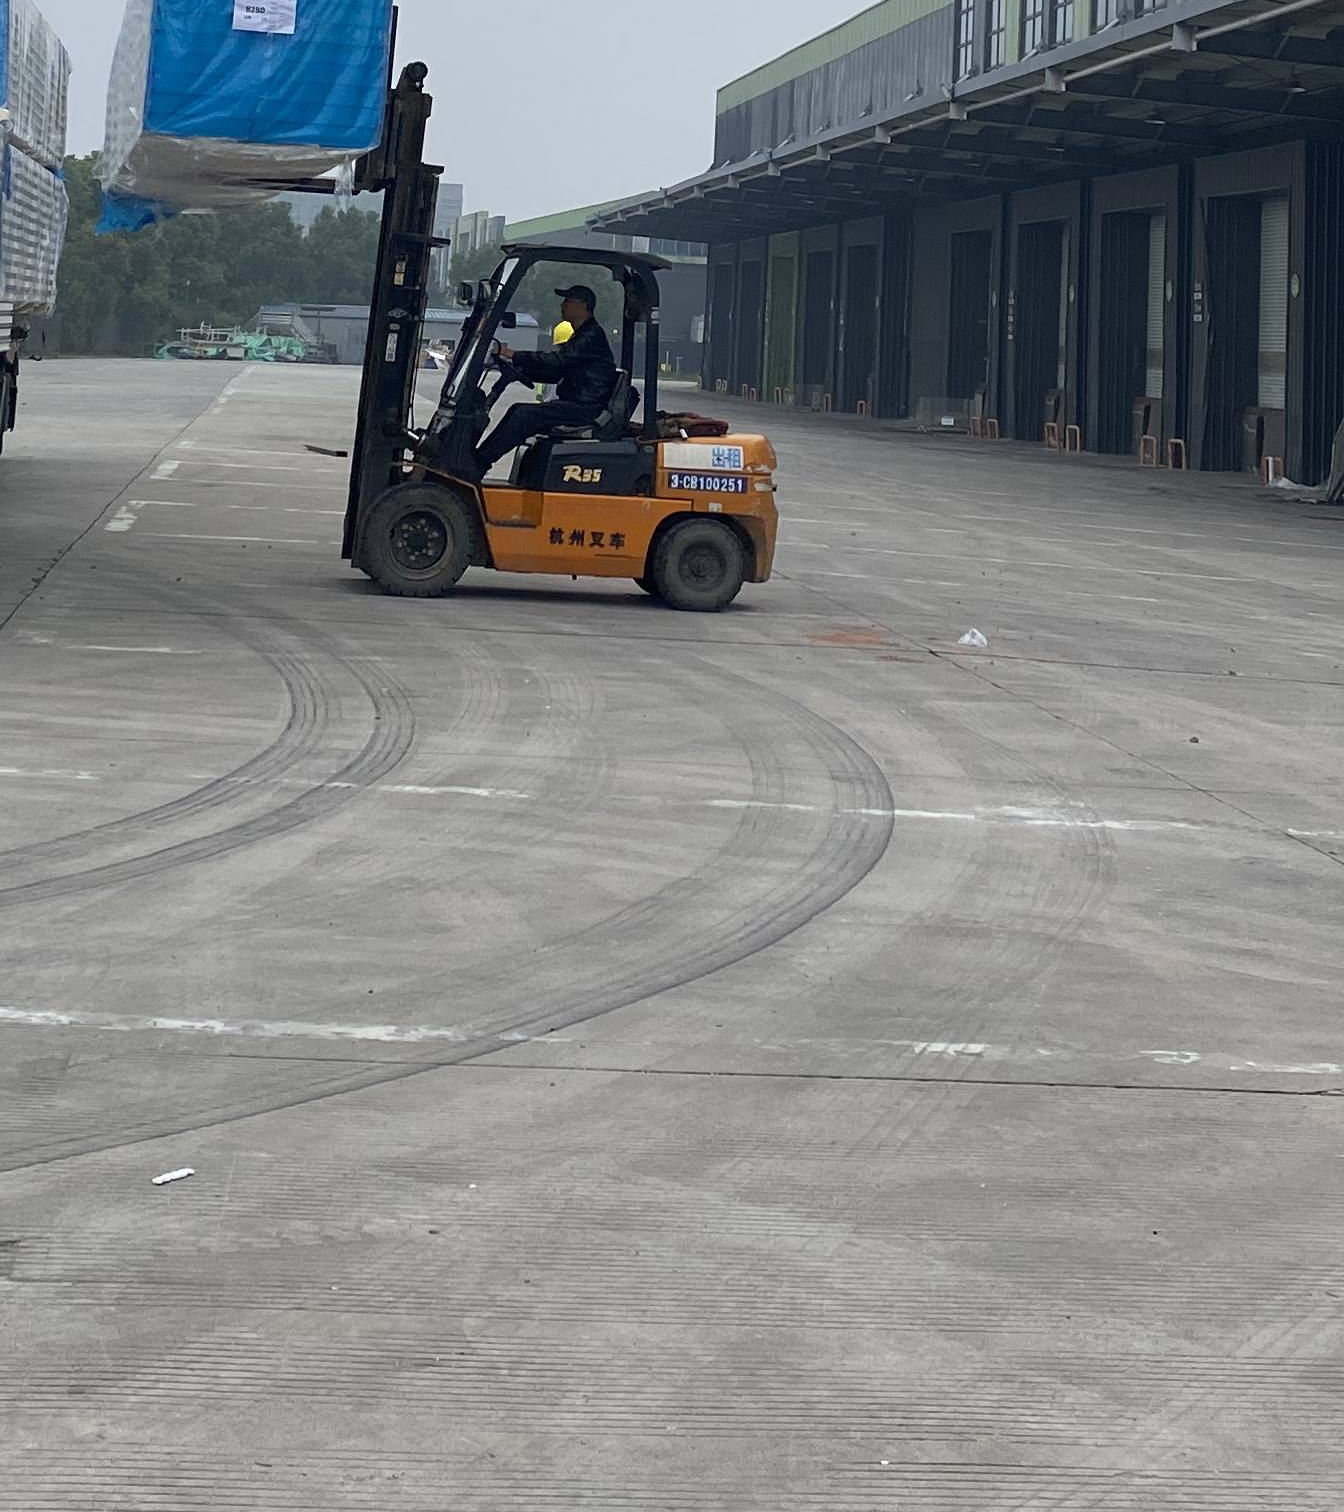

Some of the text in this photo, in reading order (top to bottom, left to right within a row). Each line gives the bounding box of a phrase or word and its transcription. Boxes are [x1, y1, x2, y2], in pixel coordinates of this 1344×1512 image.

[562, 464, 602, 483] R35
[549, 527, 626, 549] 杭州叉车
